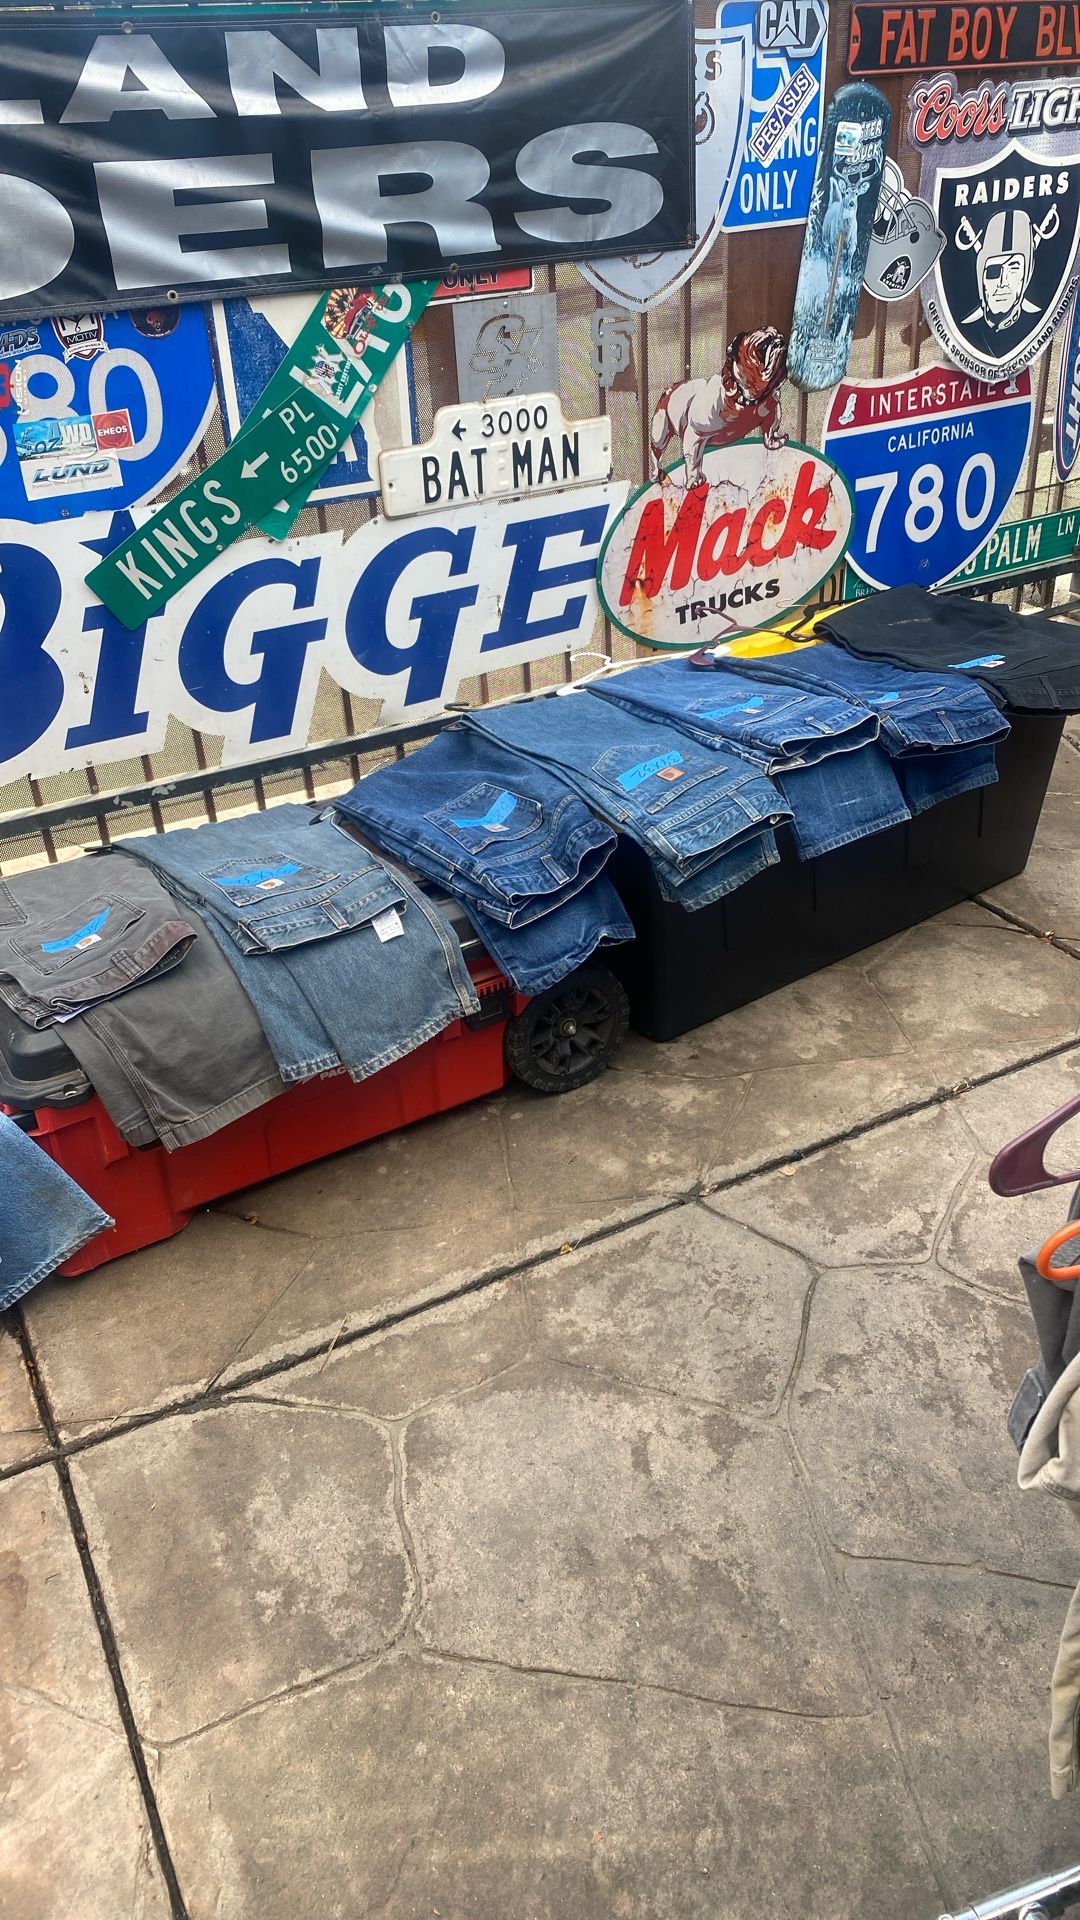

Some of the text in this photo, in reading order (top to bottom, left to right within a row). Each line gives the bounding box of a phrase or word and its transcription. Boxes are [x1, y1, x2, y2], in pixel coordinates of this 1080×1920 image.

[759, 0, 813, 48] CAT
[879, 9, 937, 65] FAT
[948, 6, 1018, 61] BOY
[0, 24, 506, 124] AND
[755, 71, 811, 156] PEGASUS
[915, 83, 1007, 142] Coors
[739, 169, 798, 215] ONLY
[953, 171, 1070, 207] RAIDERS
[442, 270, 499, 290] ONLY
[66, 330, 98, 344] MOTIV
[928, 301, 950, 347] OFFICIAL
[950, 344, 987, 378] SPONSOR
[987, 367, 999, 380] OF
[1018, 325, 1054, 366] OAKLAND
[0, 347, 164, 462] 80
[97, 425, 128, 437] ENEOS
[278, 401, 315, 435] PL
[481, 405, 548, 438] 3000
[279, 424, 338, 483] 6500
[887, 421, 974, 453] CALIFORNIA
[32, 459, 110, 484] LUND
[421, 447, 487, 504] BAT
[512, 431, 580, 488] MAN
[855, 452, 996, 554] 780
[115, 479, 241, 600] KINGS
[619, 461, 837, 607] Mack
[984, 523, 1043, 571] PALM
[1057, 515, 1076, 537] LN
[675, 579, 781, 625] TRUCKS
